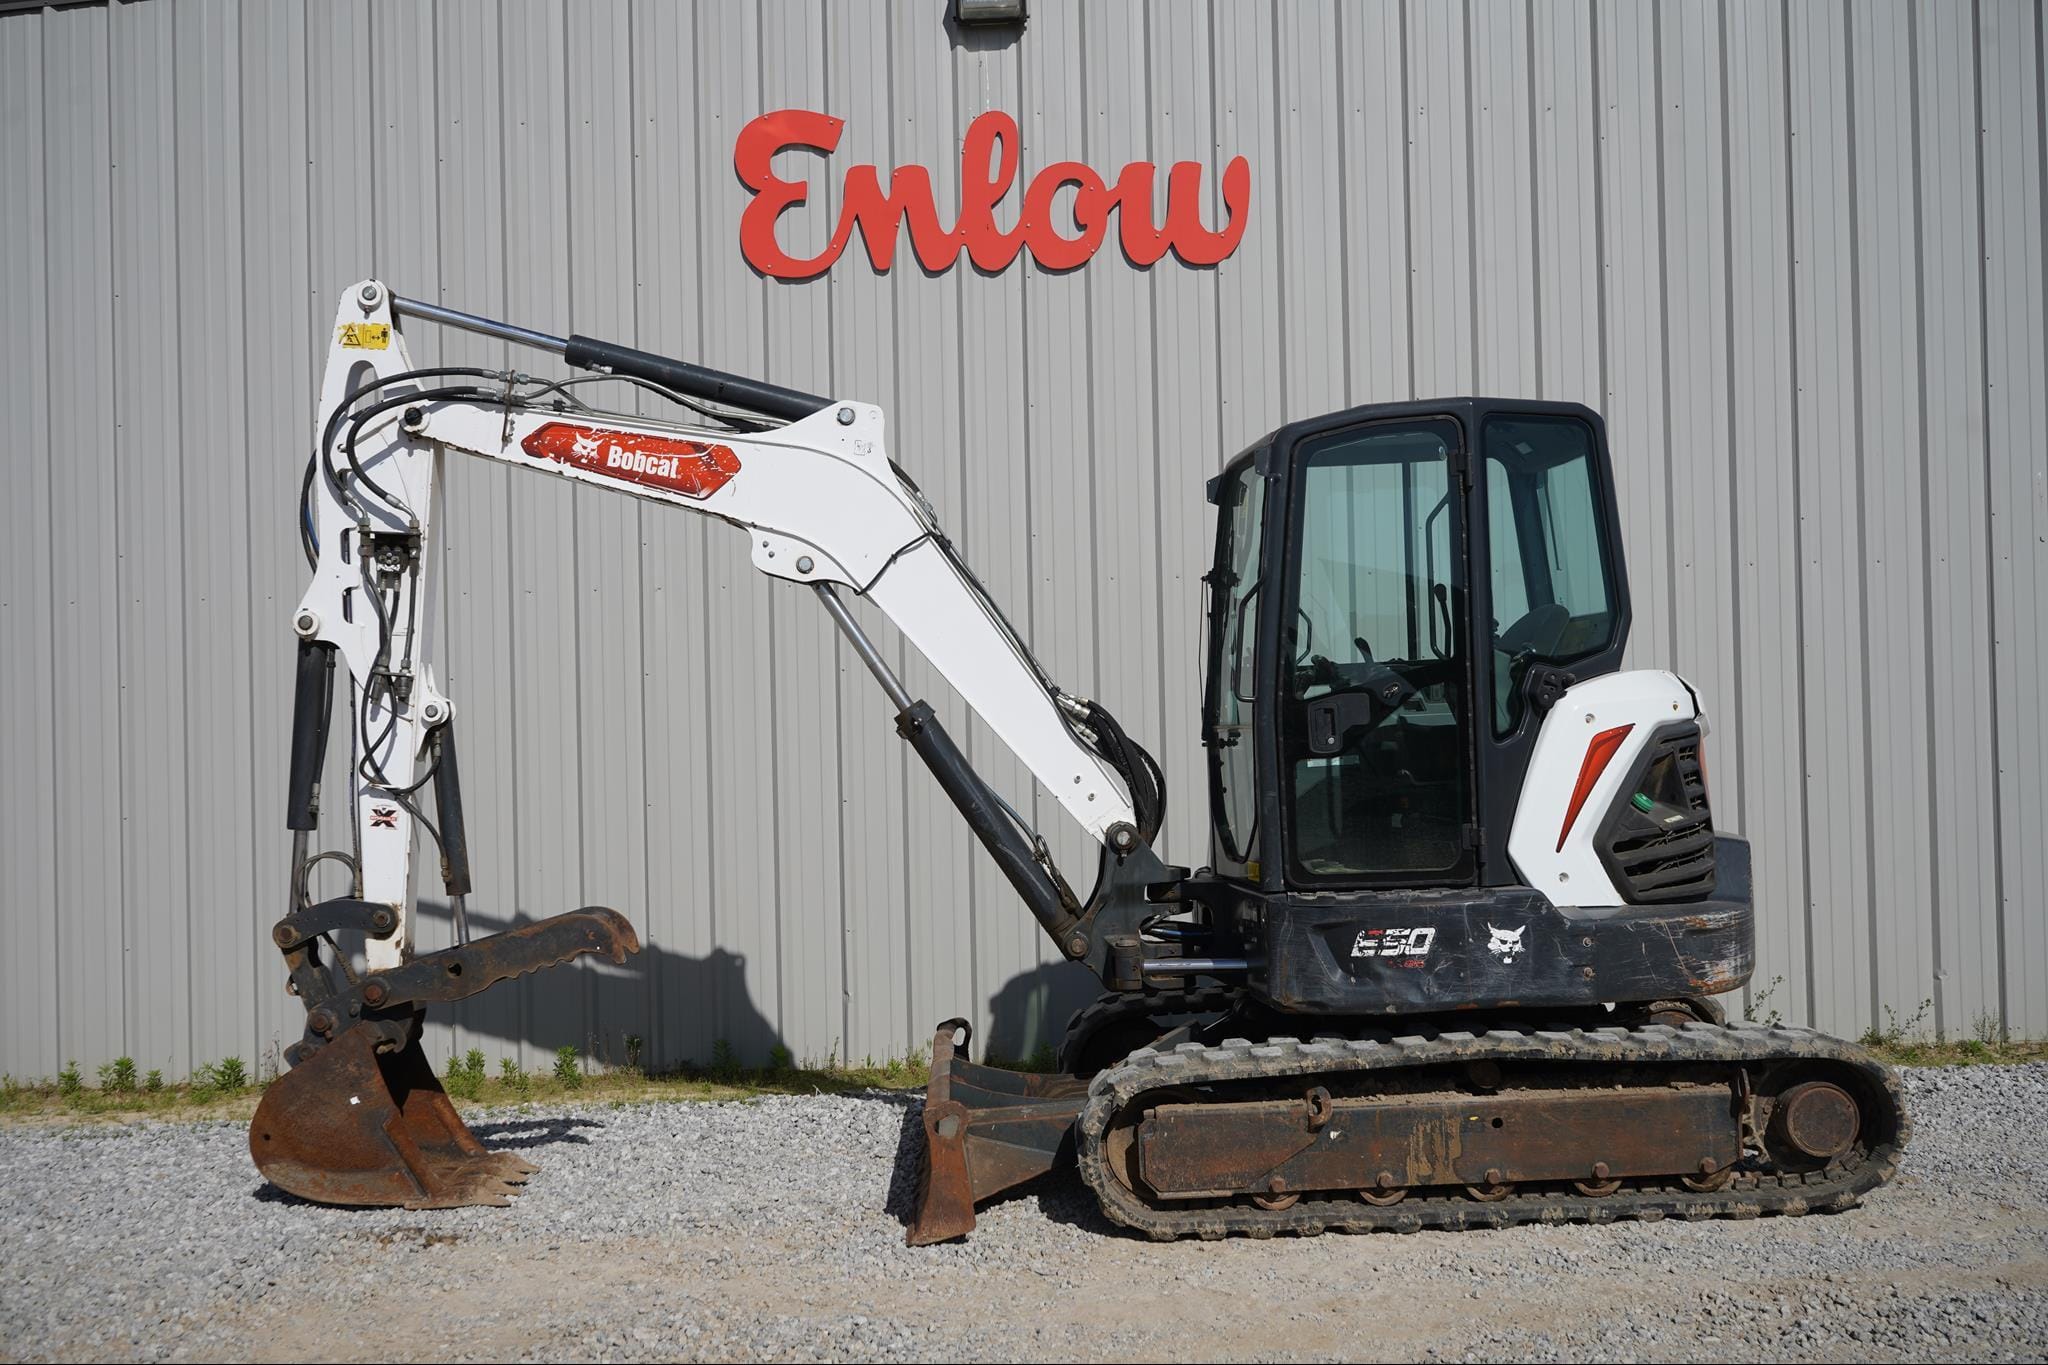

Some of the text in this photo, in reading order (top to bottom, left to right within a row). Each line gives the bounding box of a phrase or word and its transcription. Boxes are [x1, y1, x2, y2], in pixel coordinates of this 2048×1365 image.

[734, 109, 1250, 279] Enlow
[607, 446, 679, 478] Bobcat
[1350, 927, 1436, 957] E50
